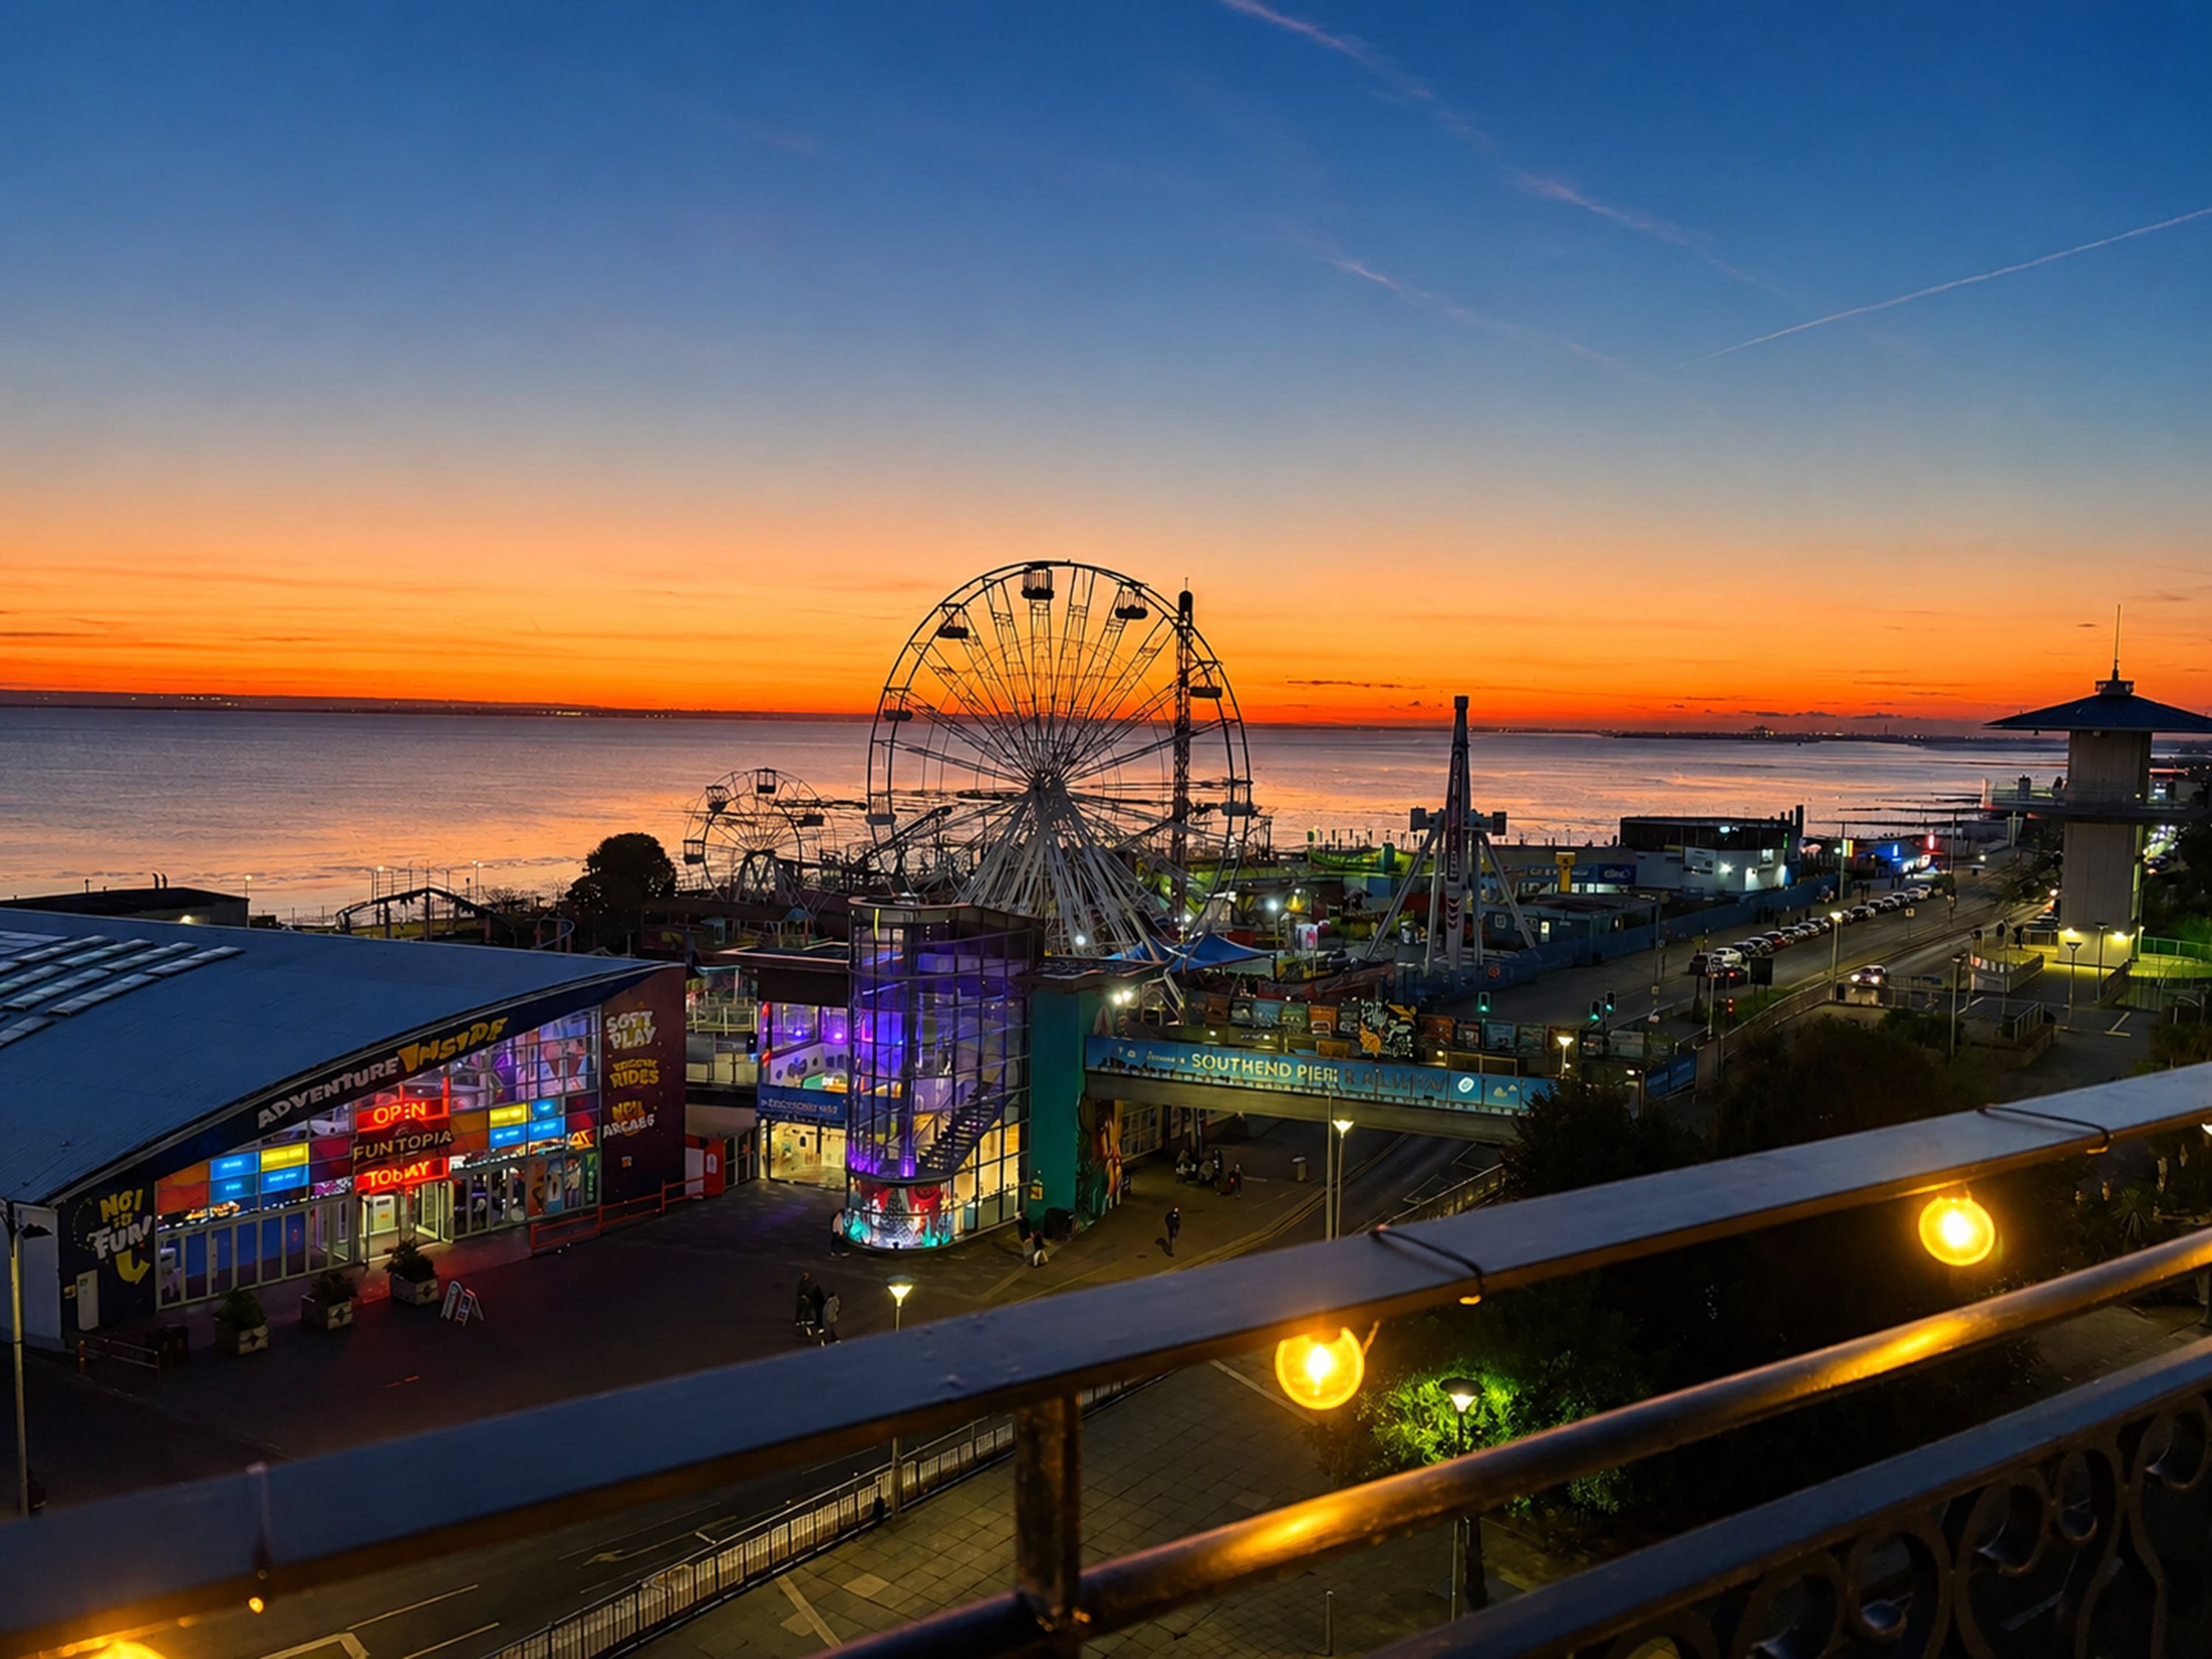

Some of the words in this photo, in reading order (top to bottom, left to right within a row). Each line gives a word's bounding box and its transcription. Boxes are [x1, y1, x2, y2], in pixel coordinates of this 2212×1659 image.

[608, 1026, 658, 1049] PLAY
[1192, 1053, 1292, 1077] SOUTHEND
[609, 1068, 660, 1088] RIDES
[258, 1057, 400, 1129] ADVENTURE
[373, 1102, 426, 1124] OPEN
[353, 1130, 452, 1161] FUNTOPIA
